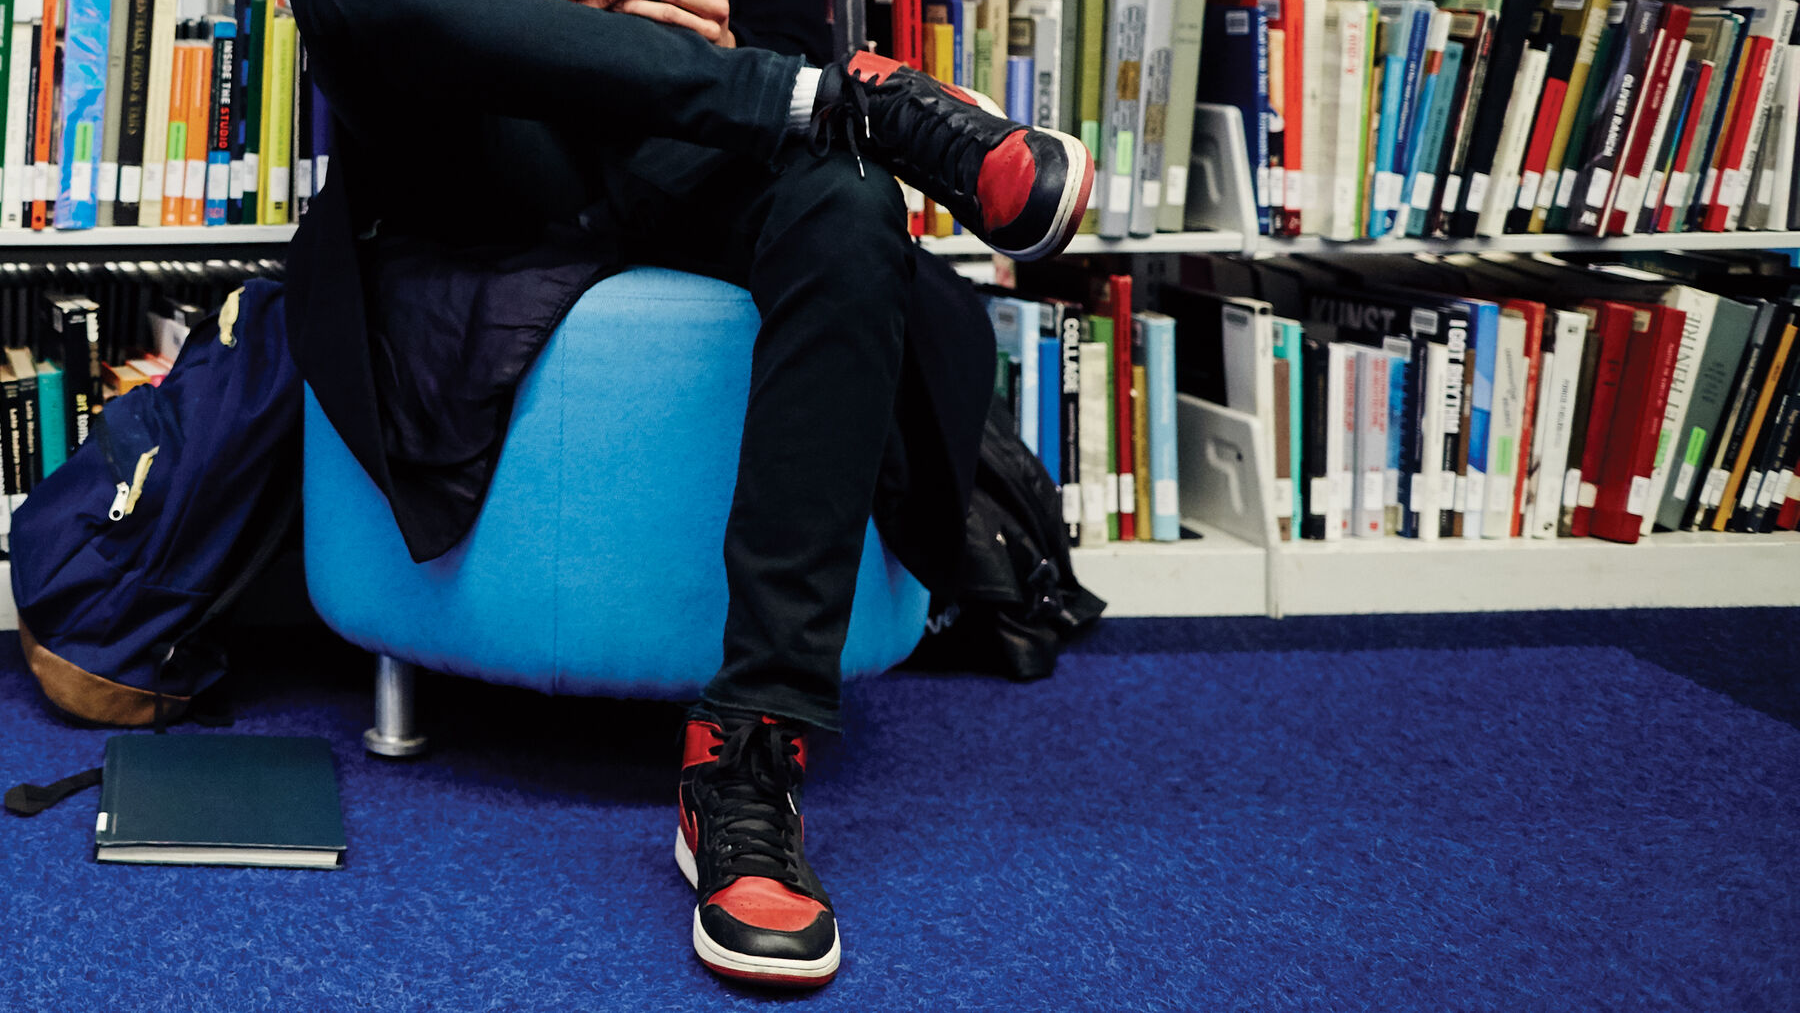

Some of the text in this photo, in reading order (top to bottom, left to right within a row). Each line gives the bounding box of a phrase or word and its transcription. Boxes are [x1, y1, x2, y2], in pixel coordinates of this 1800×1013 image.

[130, 54, 144, 90] HEADS
[218, 40, 234, 149] INSIDE THE STUDIO
[127, 106, 141, 135] TAILS
[1603, 74, 1635, 157] OLIVER RANCH
[1310, 296, 1397, 333] KUNST
[76, 394, 89, 412] art
[11, 430, 20, 464] Modern
